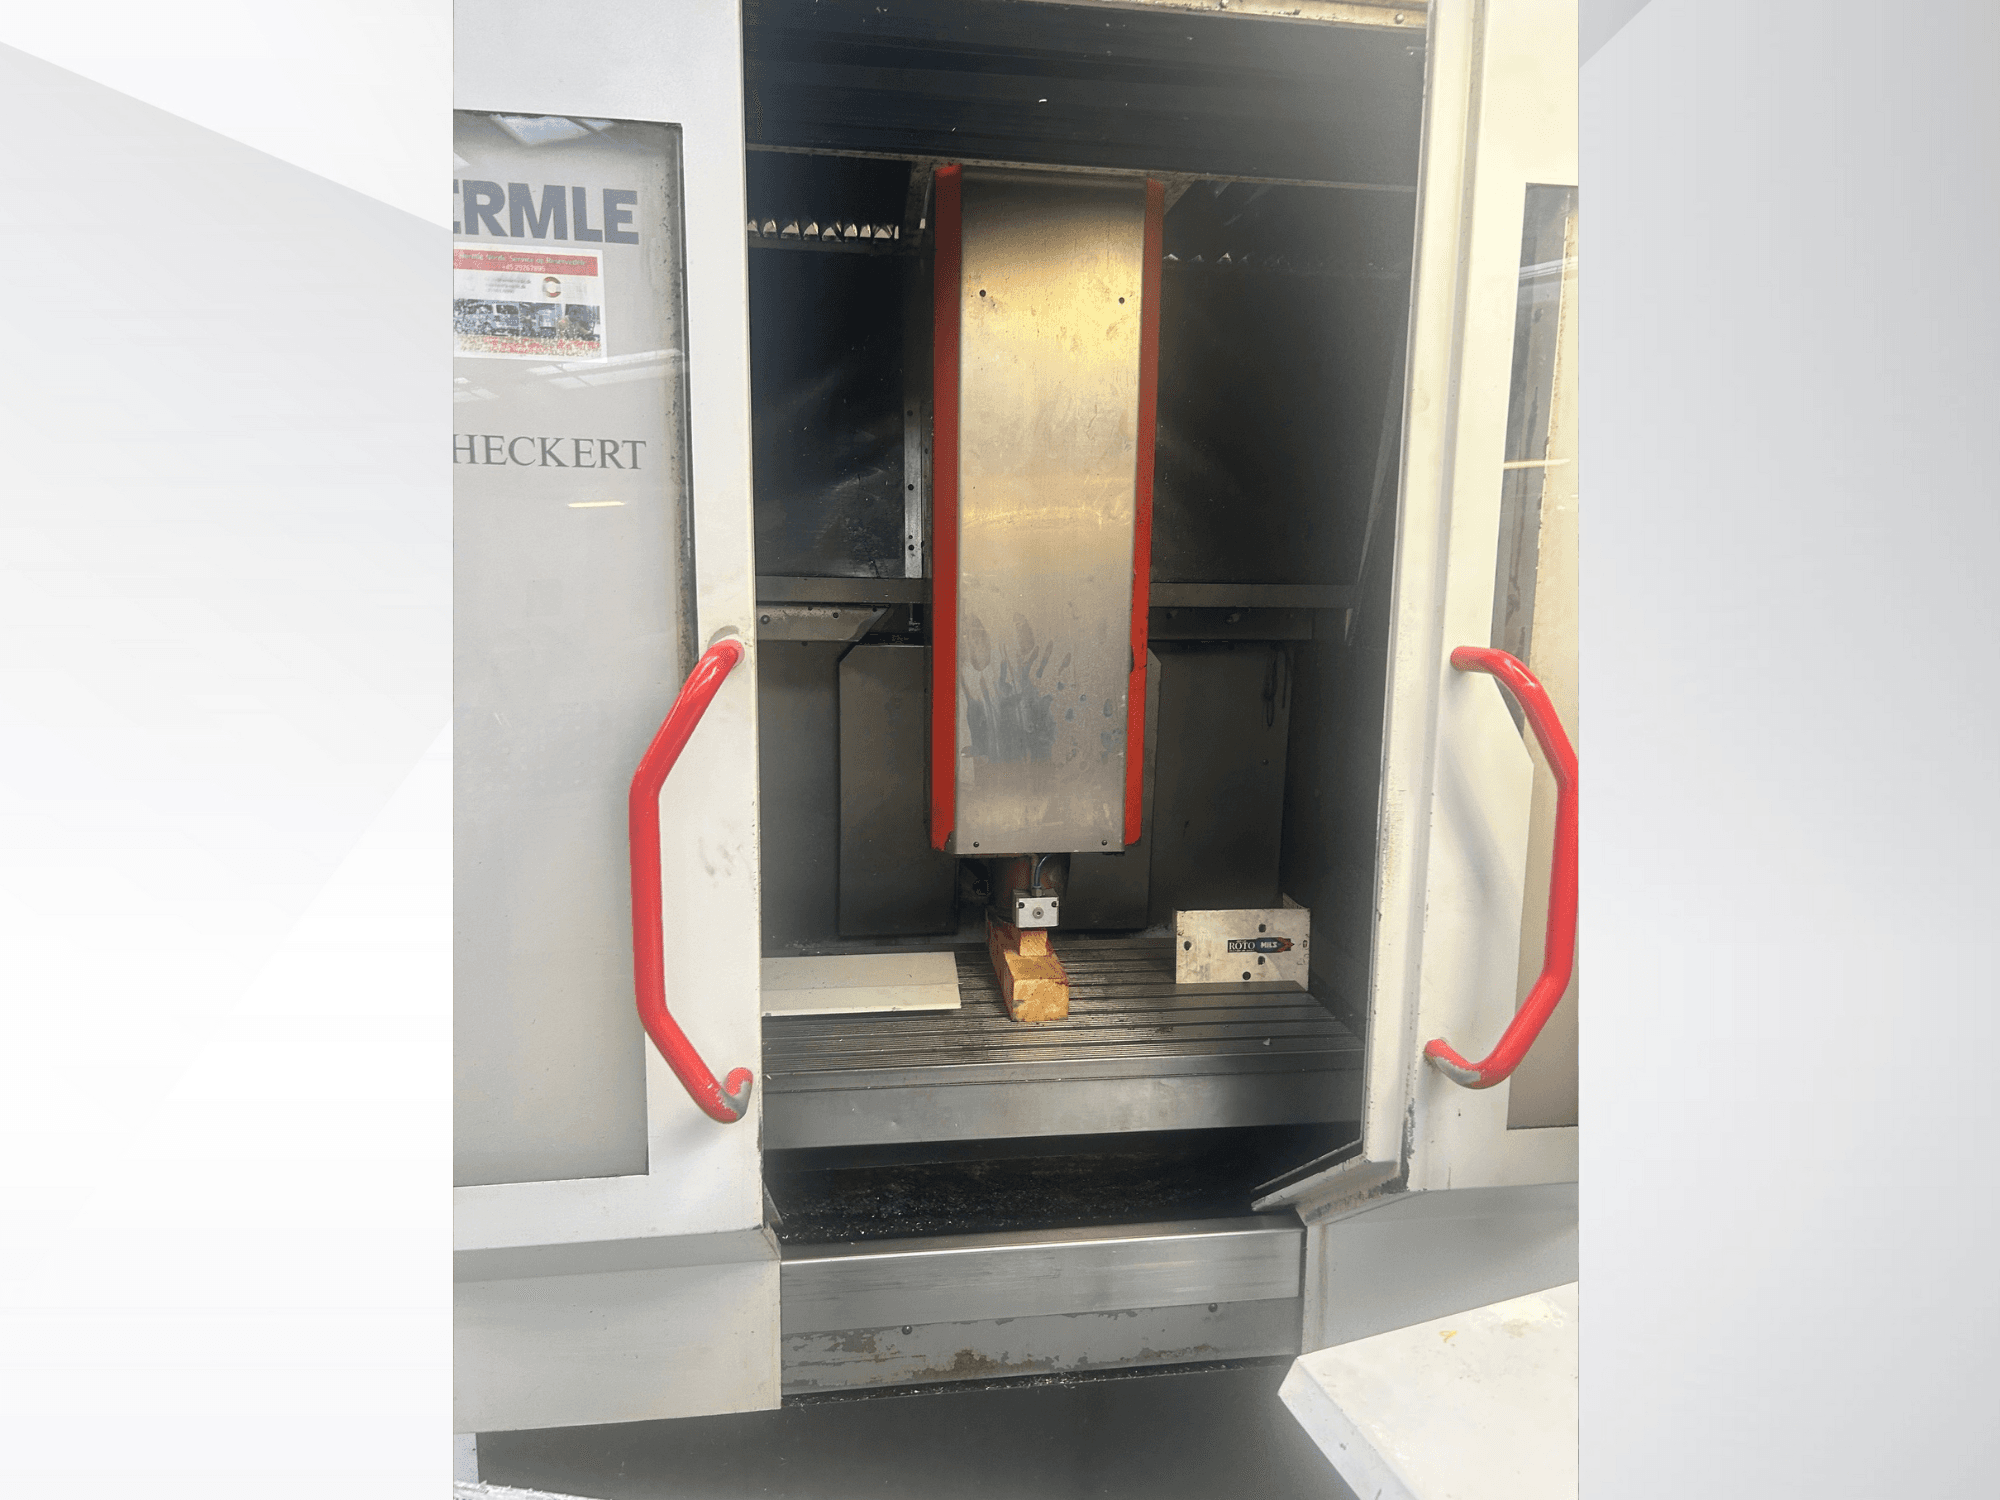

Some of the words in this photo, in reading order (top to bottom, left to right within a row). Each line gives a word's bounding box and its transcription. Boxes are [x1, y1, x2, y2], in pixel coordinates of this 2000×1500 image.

[453, 179, 638, 245] RMLE
[453, 433, 647, 470] HECKERT
[1229, 941, 1256, 950] ROTO
